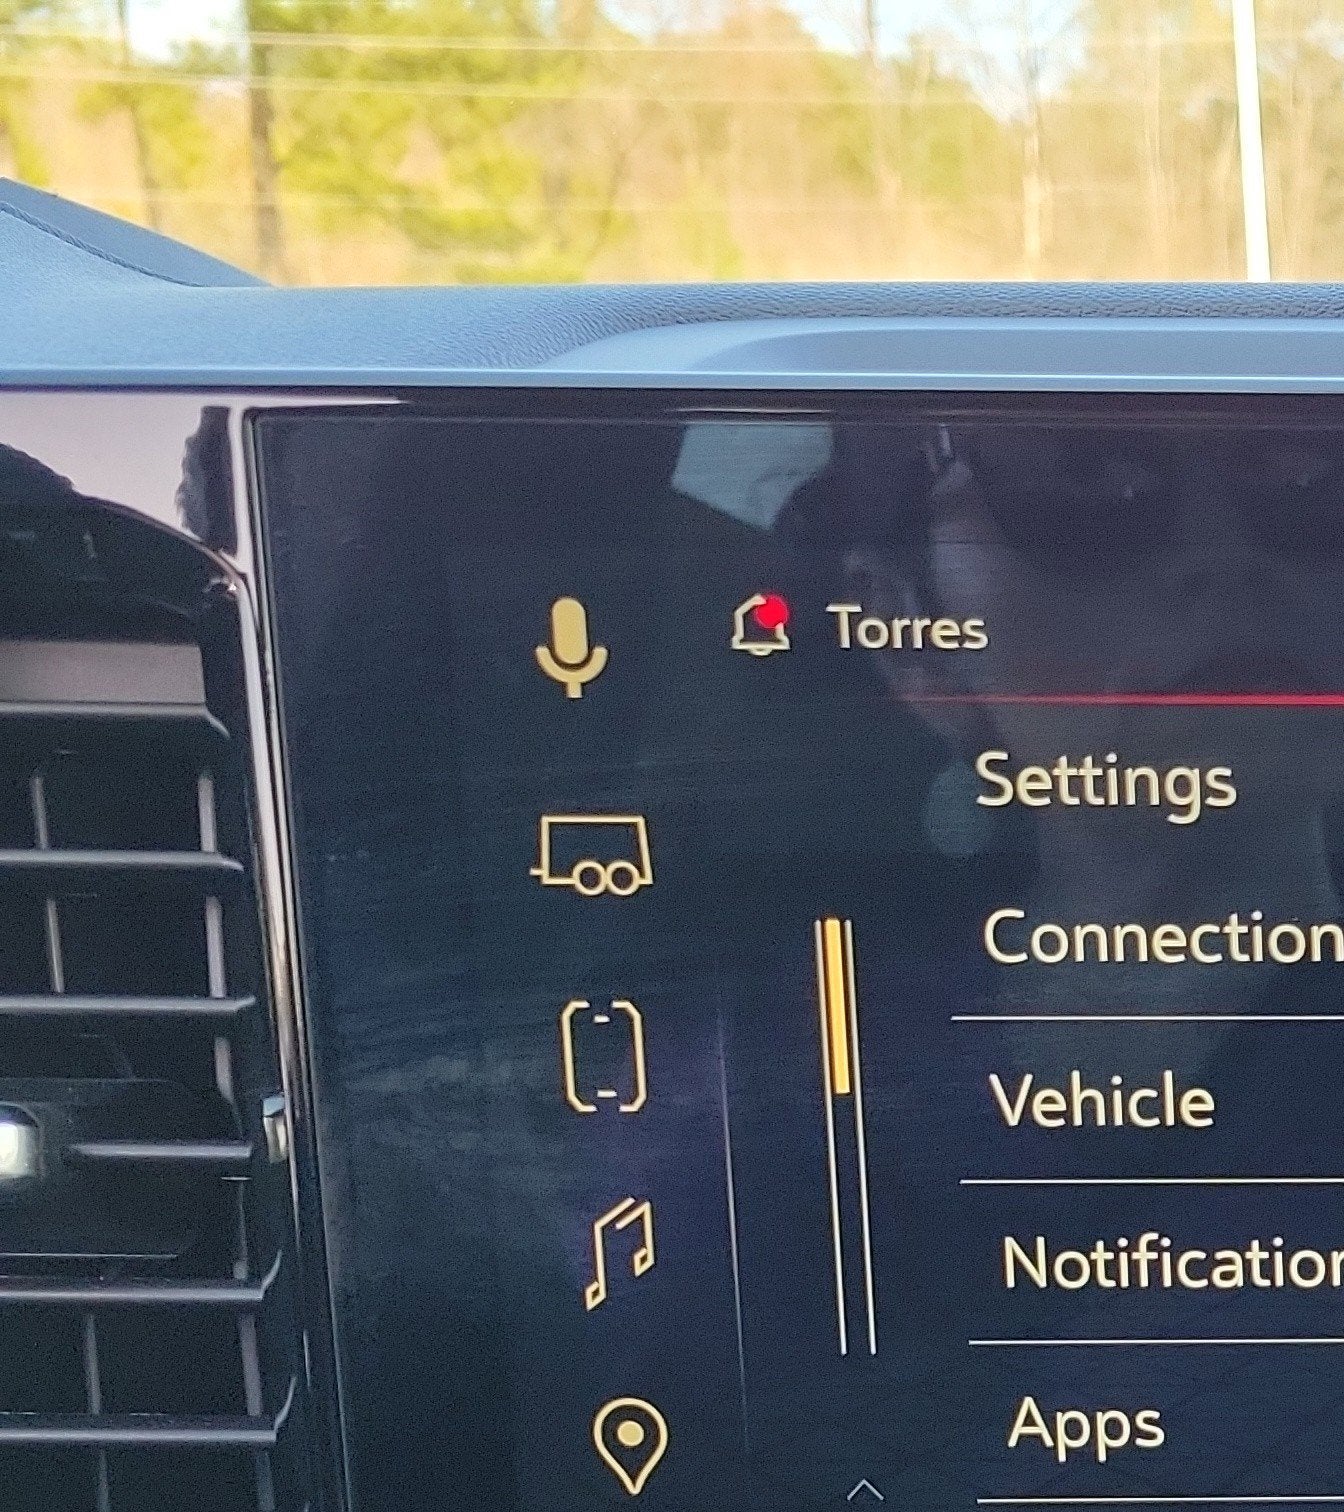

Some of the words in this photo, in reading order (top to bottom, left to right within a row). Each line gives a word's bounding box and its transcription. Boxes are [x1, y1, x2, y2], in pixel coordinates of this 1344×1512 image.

[826, 604, 989, 650] Torres
[976, 750, 1237, 825] Settings
[989, 1069, 1215, 1128] Vehicle
[1007, 1396, 1165, 1463] Apps
